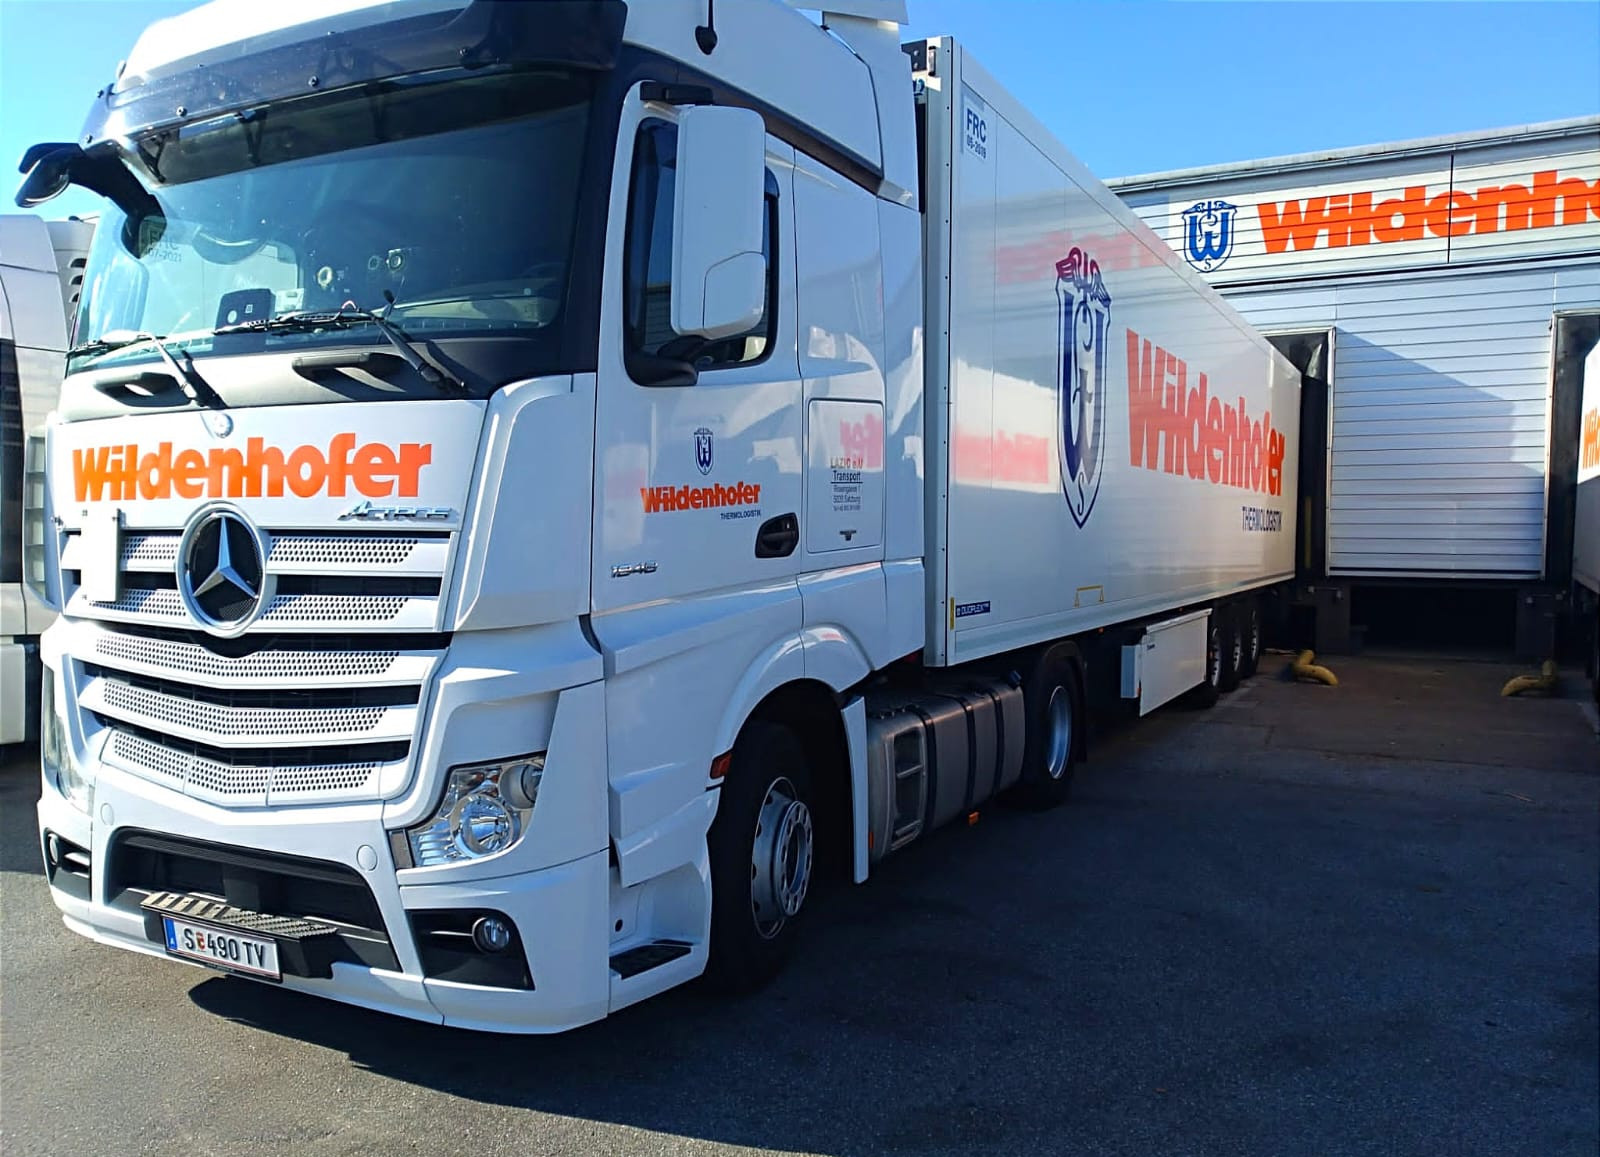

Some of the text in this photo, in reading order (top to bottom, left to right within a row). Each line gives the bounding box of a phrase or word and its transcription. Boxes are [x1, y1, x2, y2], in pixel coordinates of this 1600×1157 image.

[967, 107, 987, 143] FRC
[1256, 170, 1600, 254] Wildenh
[1126, 328, 1285, 496] Wildenhofer
[72, 432, 432, 502] Wildenhofer
[832, 469, 861, 482] Transport
[640, 480, 761, 513] Wildenhofer
[720, 509, 761, 521] THERMOLOGISTIK
[1242, 505, 1283, 532] THERMOLOGISTIK
[184, 928, 195, 950] S
[207, 933, 239, 961] 490
